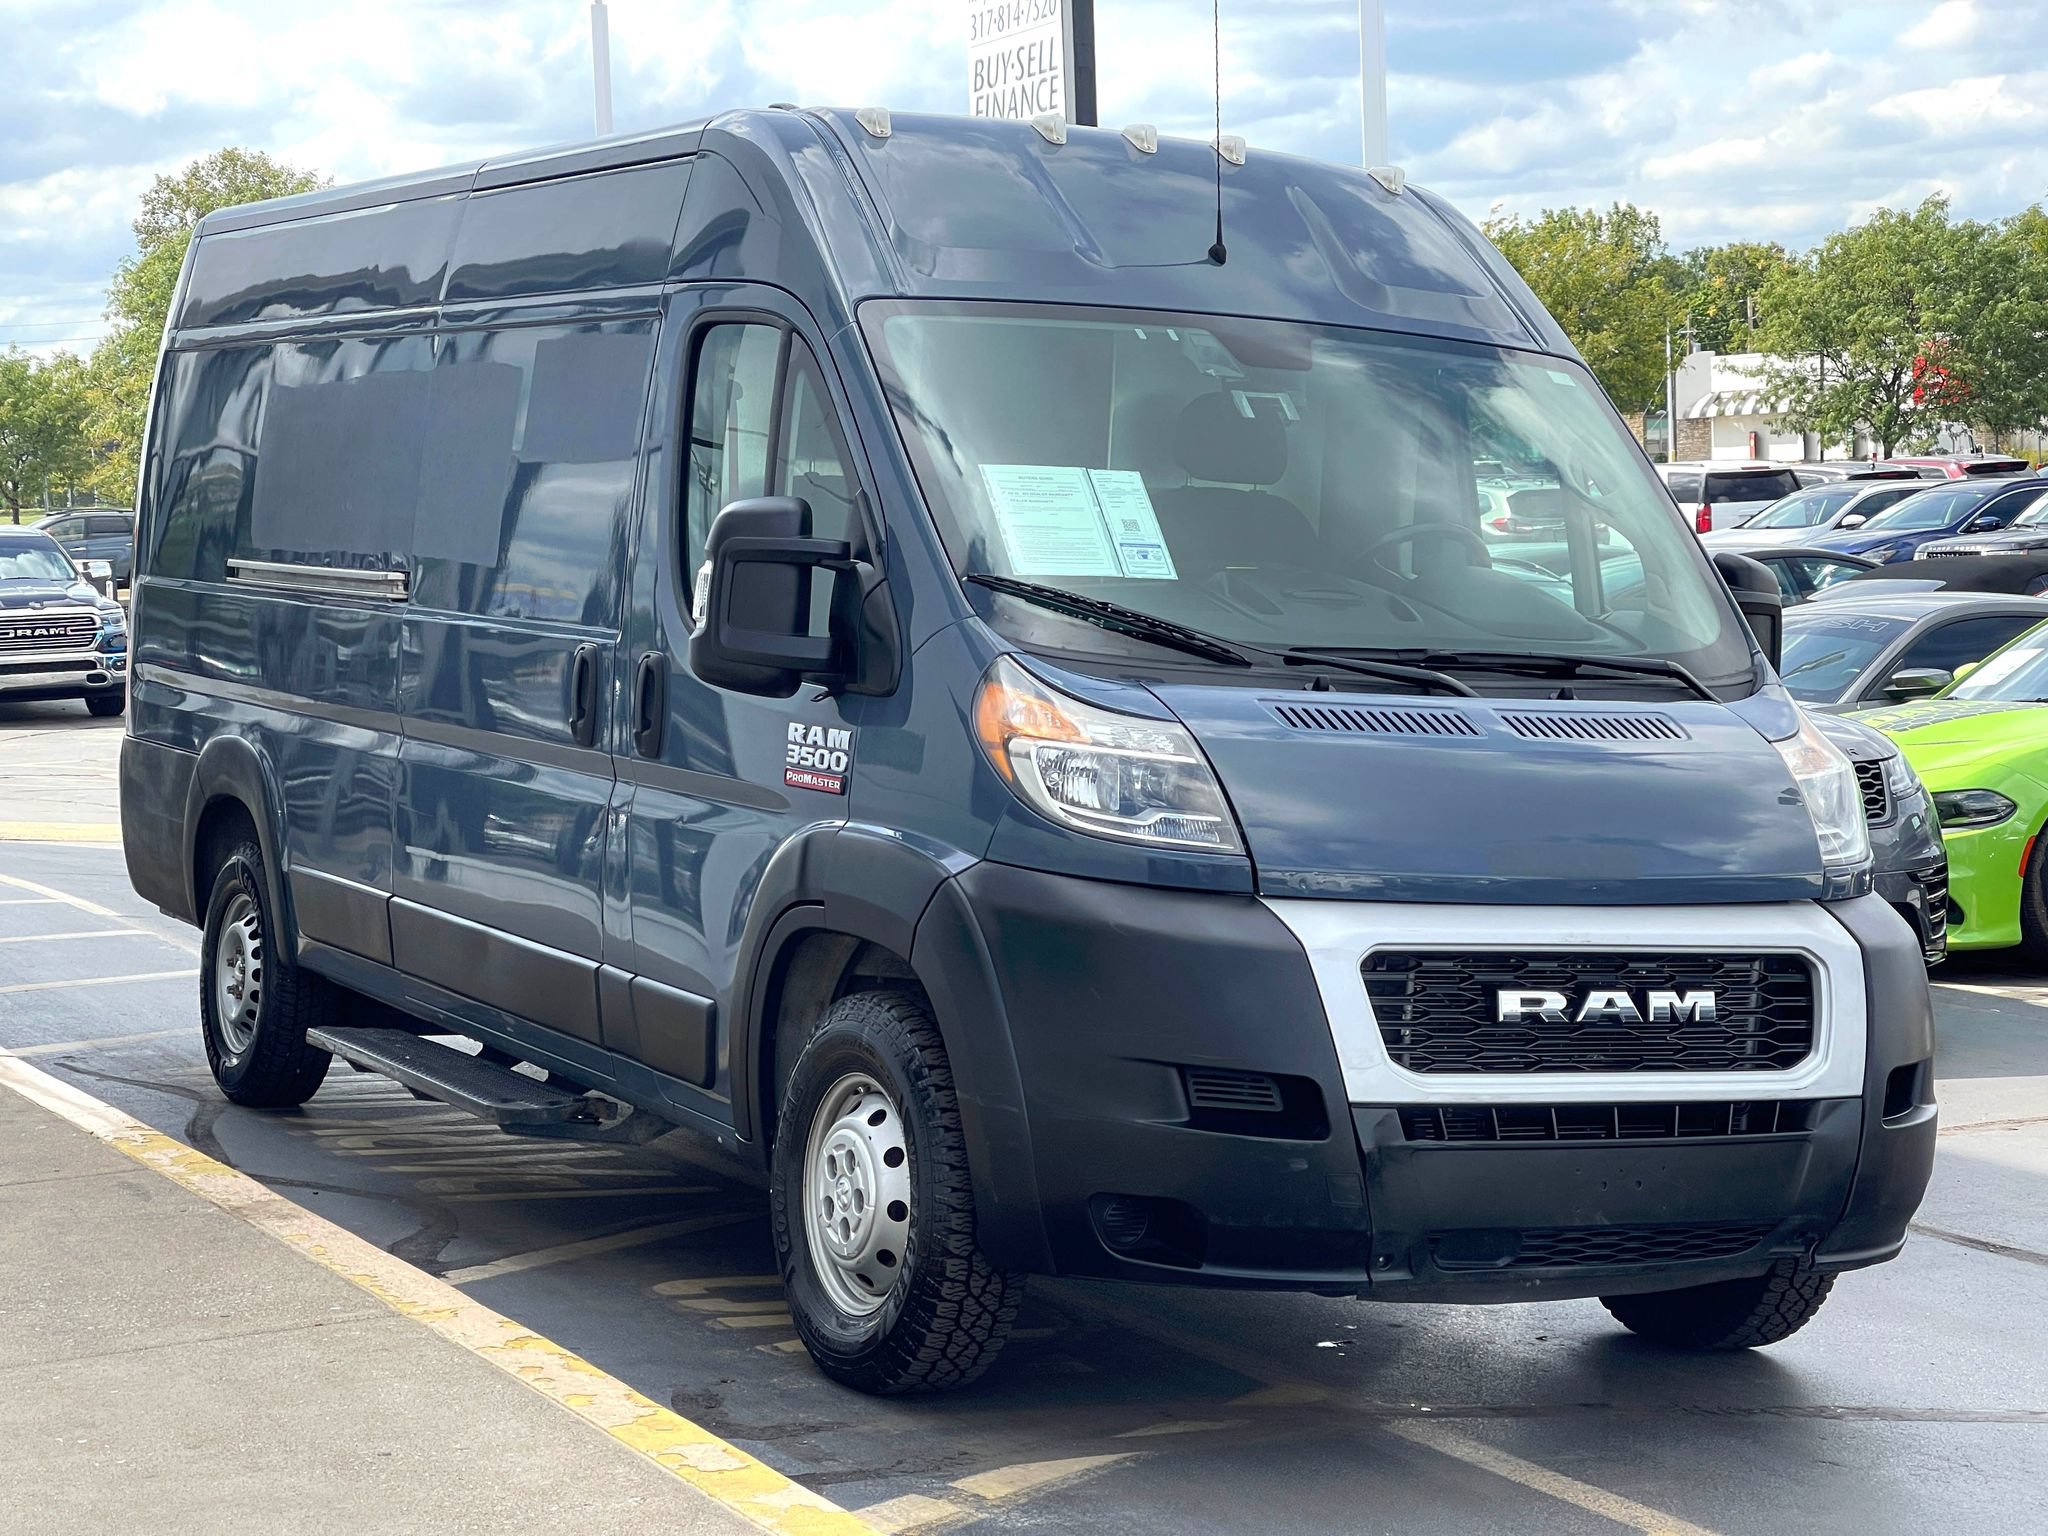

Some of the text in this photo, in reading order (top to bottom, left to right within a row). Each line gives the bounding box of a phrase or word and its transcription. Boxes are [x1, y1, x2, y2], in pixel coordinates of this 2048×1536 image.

[976, 75, 1058, 119] FINANCE
[16, 628, 66, 637] RAM
[787, 722, 852, 750] RAM
[786, 743, 849, 772] 3500
[1498, 990, 1716, 1022] RAM
